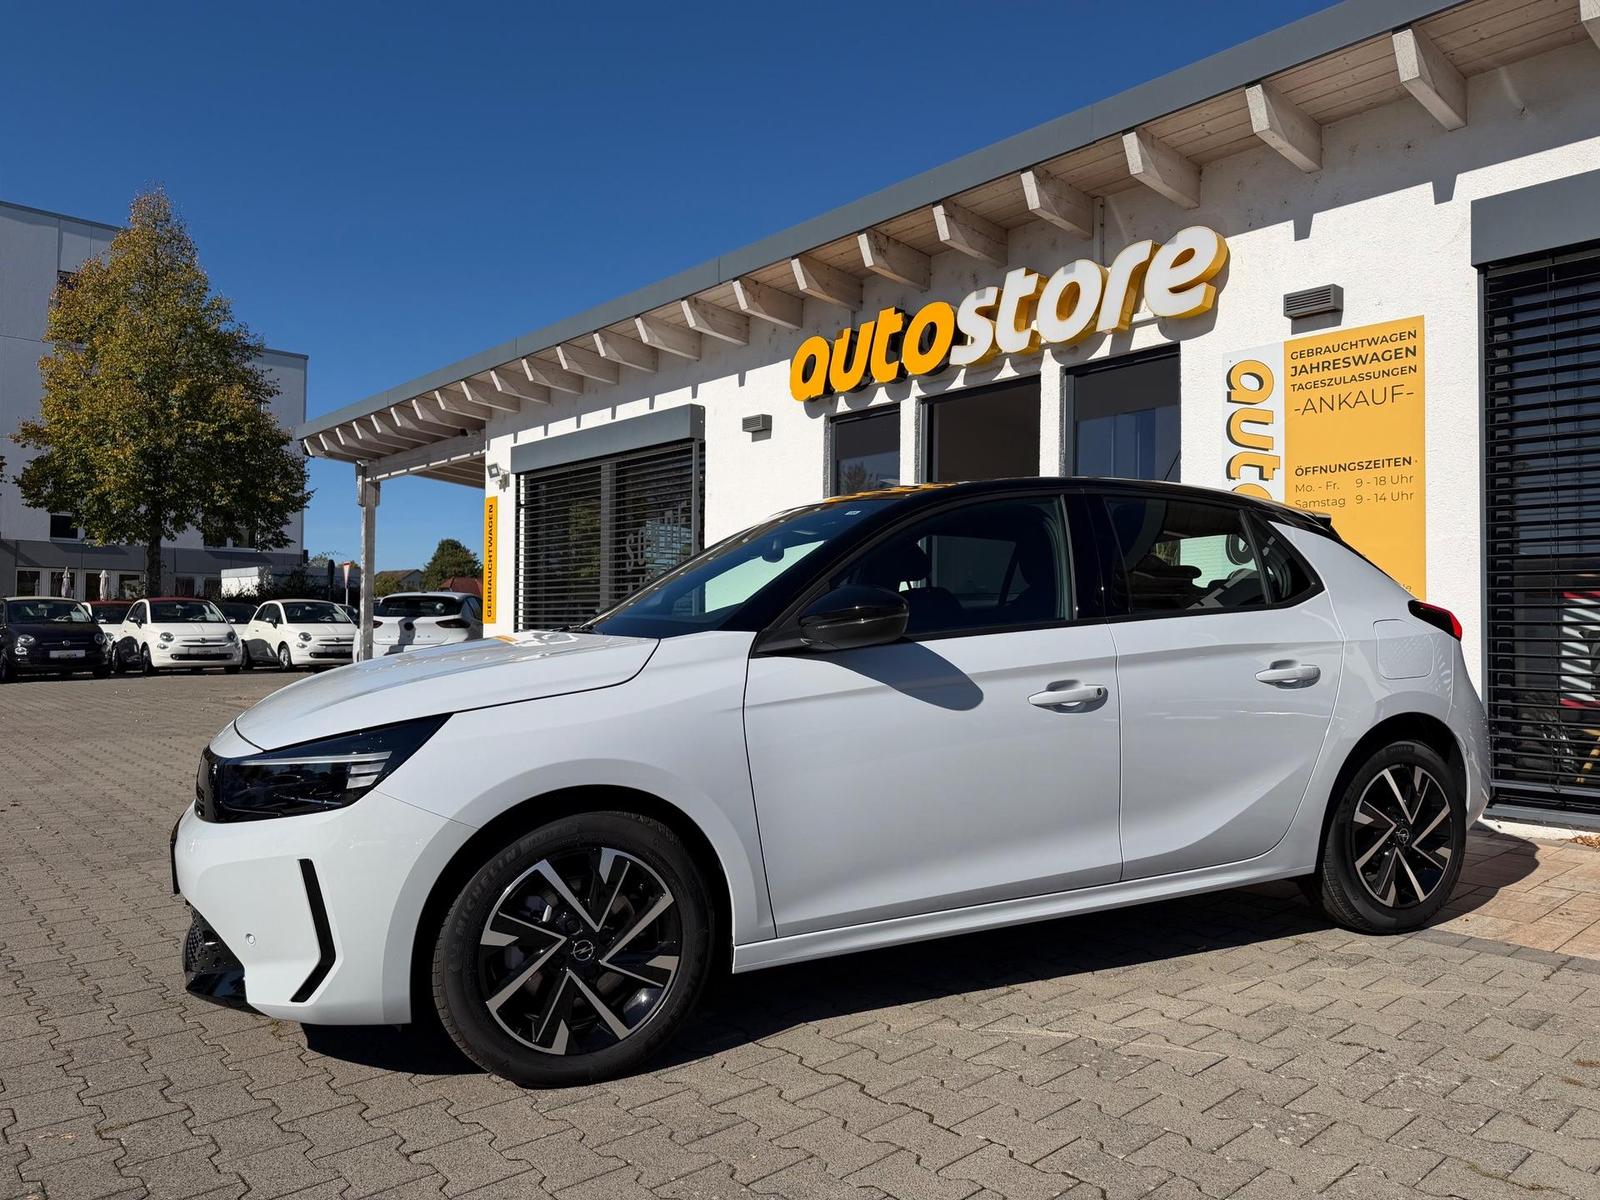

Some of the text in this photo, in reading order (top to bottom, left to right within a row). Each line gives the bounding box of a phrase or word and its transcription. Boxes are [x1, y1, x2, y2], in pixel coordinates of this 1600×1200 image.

[790, 226, 1229, 402] autostore
[1290, 329, 1417, 360] GEBRAUCHTWAGEN
[1290, 345, 1417, 377] JAHRESWAGEN
[1290, 365, 1417, 392] TAGESZULASSUNGEN
[1294, 384, 1415, 416] -ANKAUF-
[1295, 456, 1412, 476] ÖFFNUNGSZEITEN
[1295, 482, 1315, 493] Mo.
[1325, 480, 1339, 491] Fr.
[1355, 478, 1363, 488] 9
[1374, 476, 1387, 487] 18
[1390, 474, 1413, 485] Uhr
[1295, 496, 1346, 508] Samstag
[1355, 494, 1363, 505] 9
[1374, 493, 1387, 503] 14
[1390, 491, 1414, 502] Uhr
